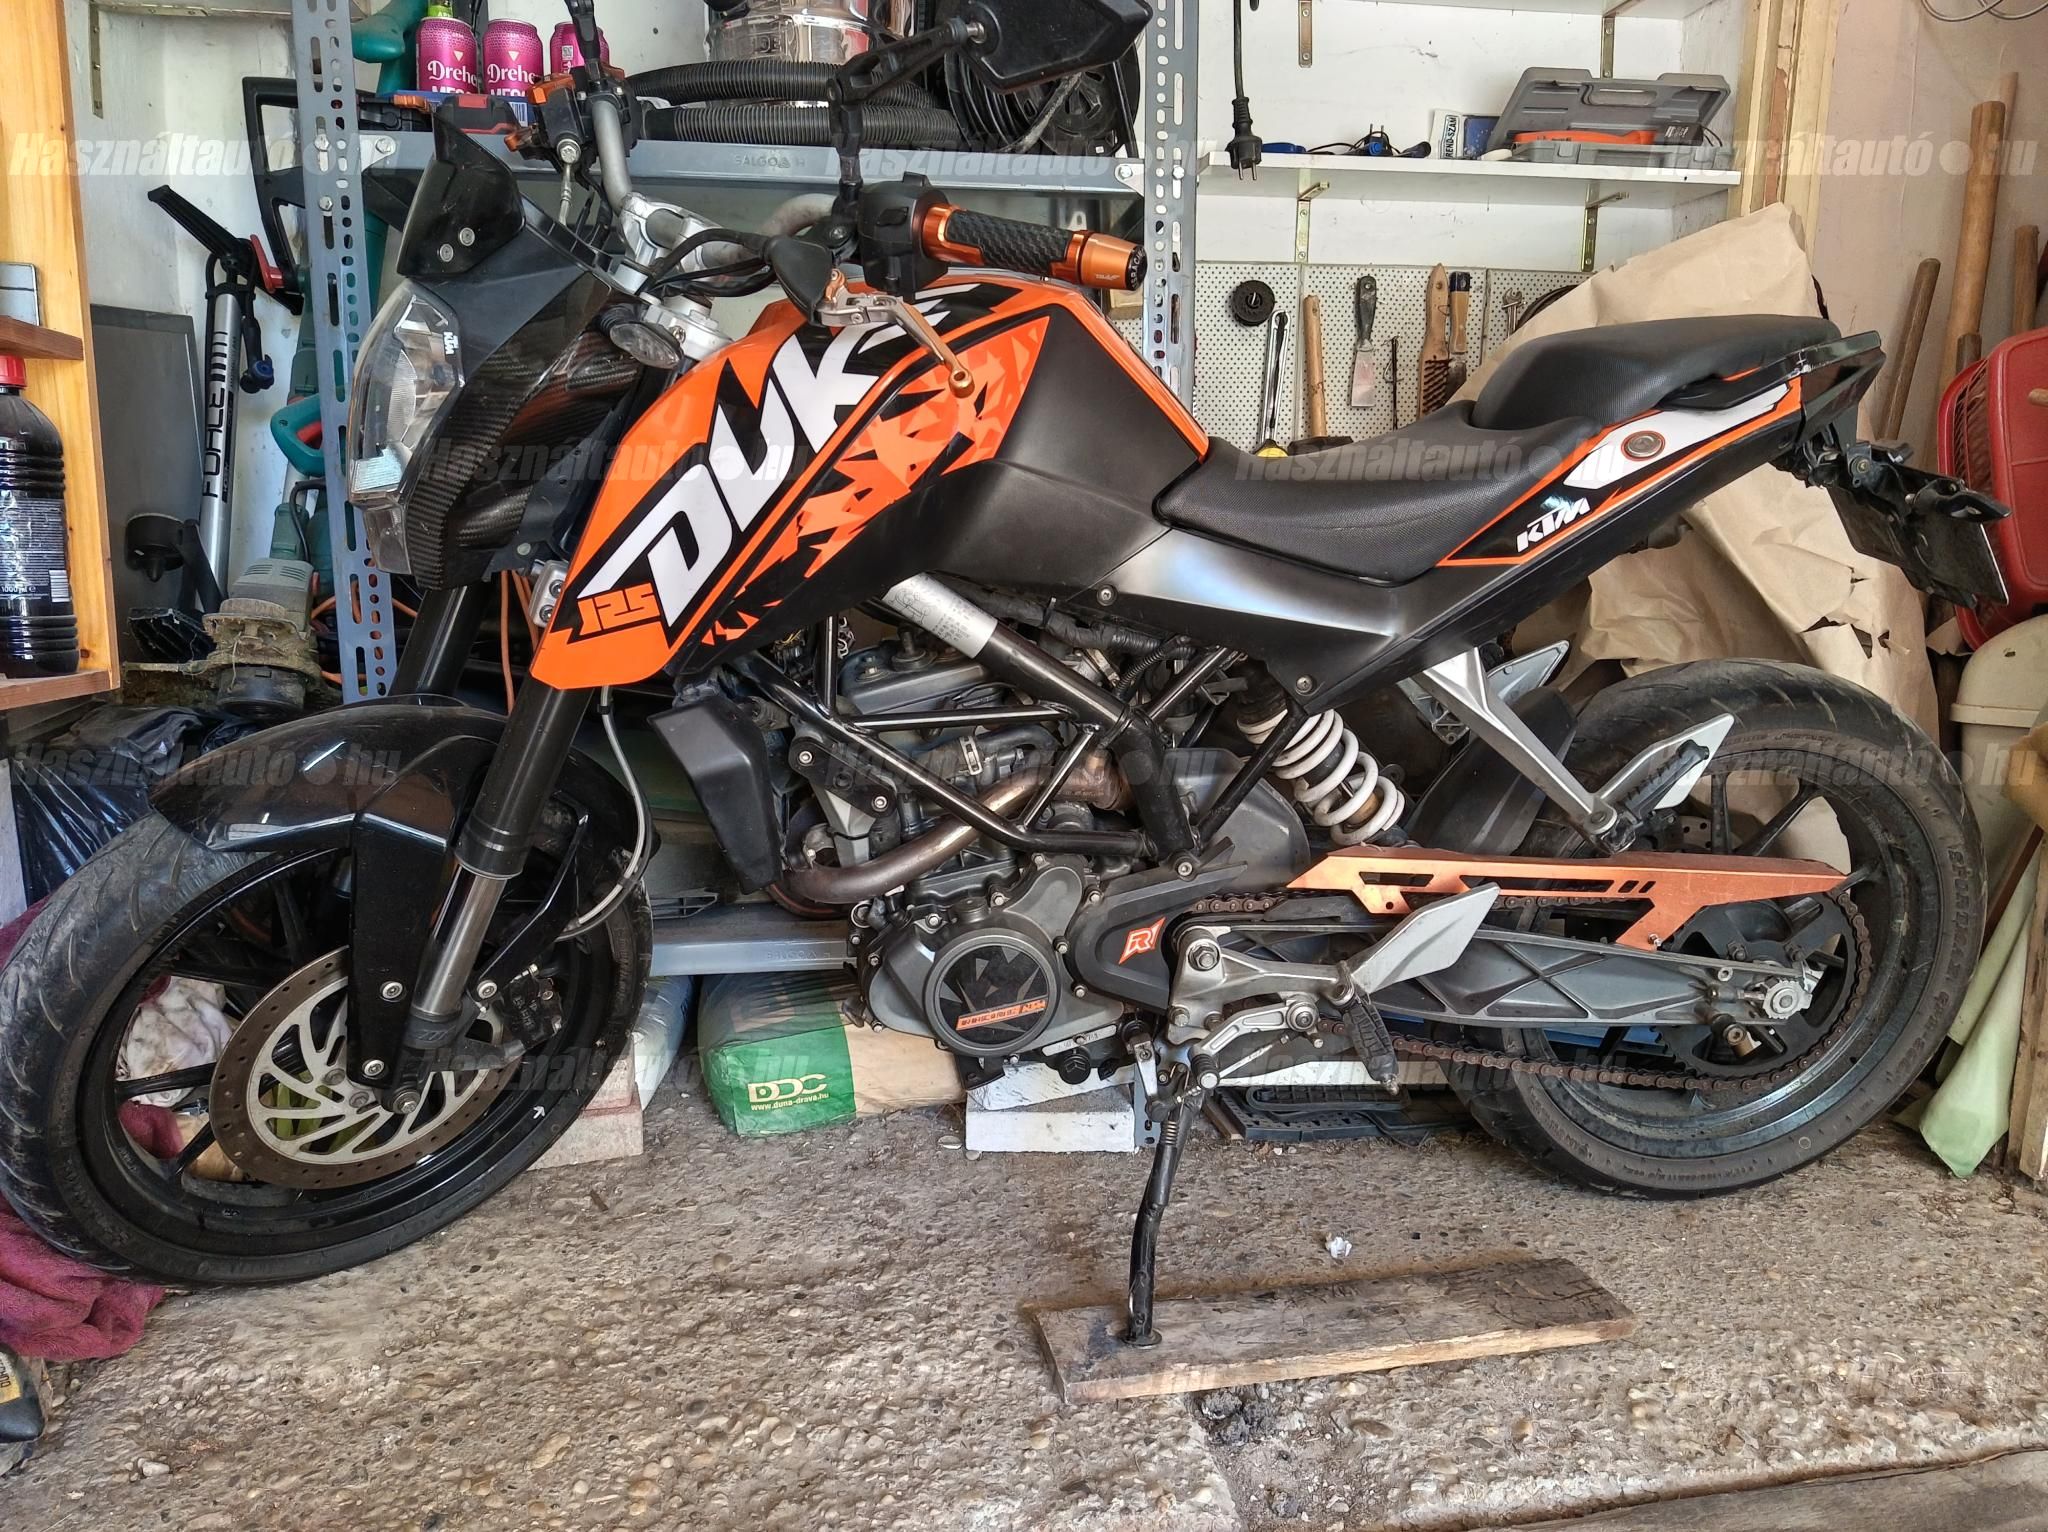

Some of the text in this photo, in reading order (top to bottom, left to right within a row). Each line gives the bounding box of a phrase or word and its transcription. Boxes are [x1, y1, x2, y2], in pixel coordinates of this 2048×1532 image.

[1516, 497, 1591, 553] KTM
[578, 583, 661, 635] 125
[747, 1073, 828, 1104] DDC
[751, 1093, 830, 1112] www.duna-drava.hu
